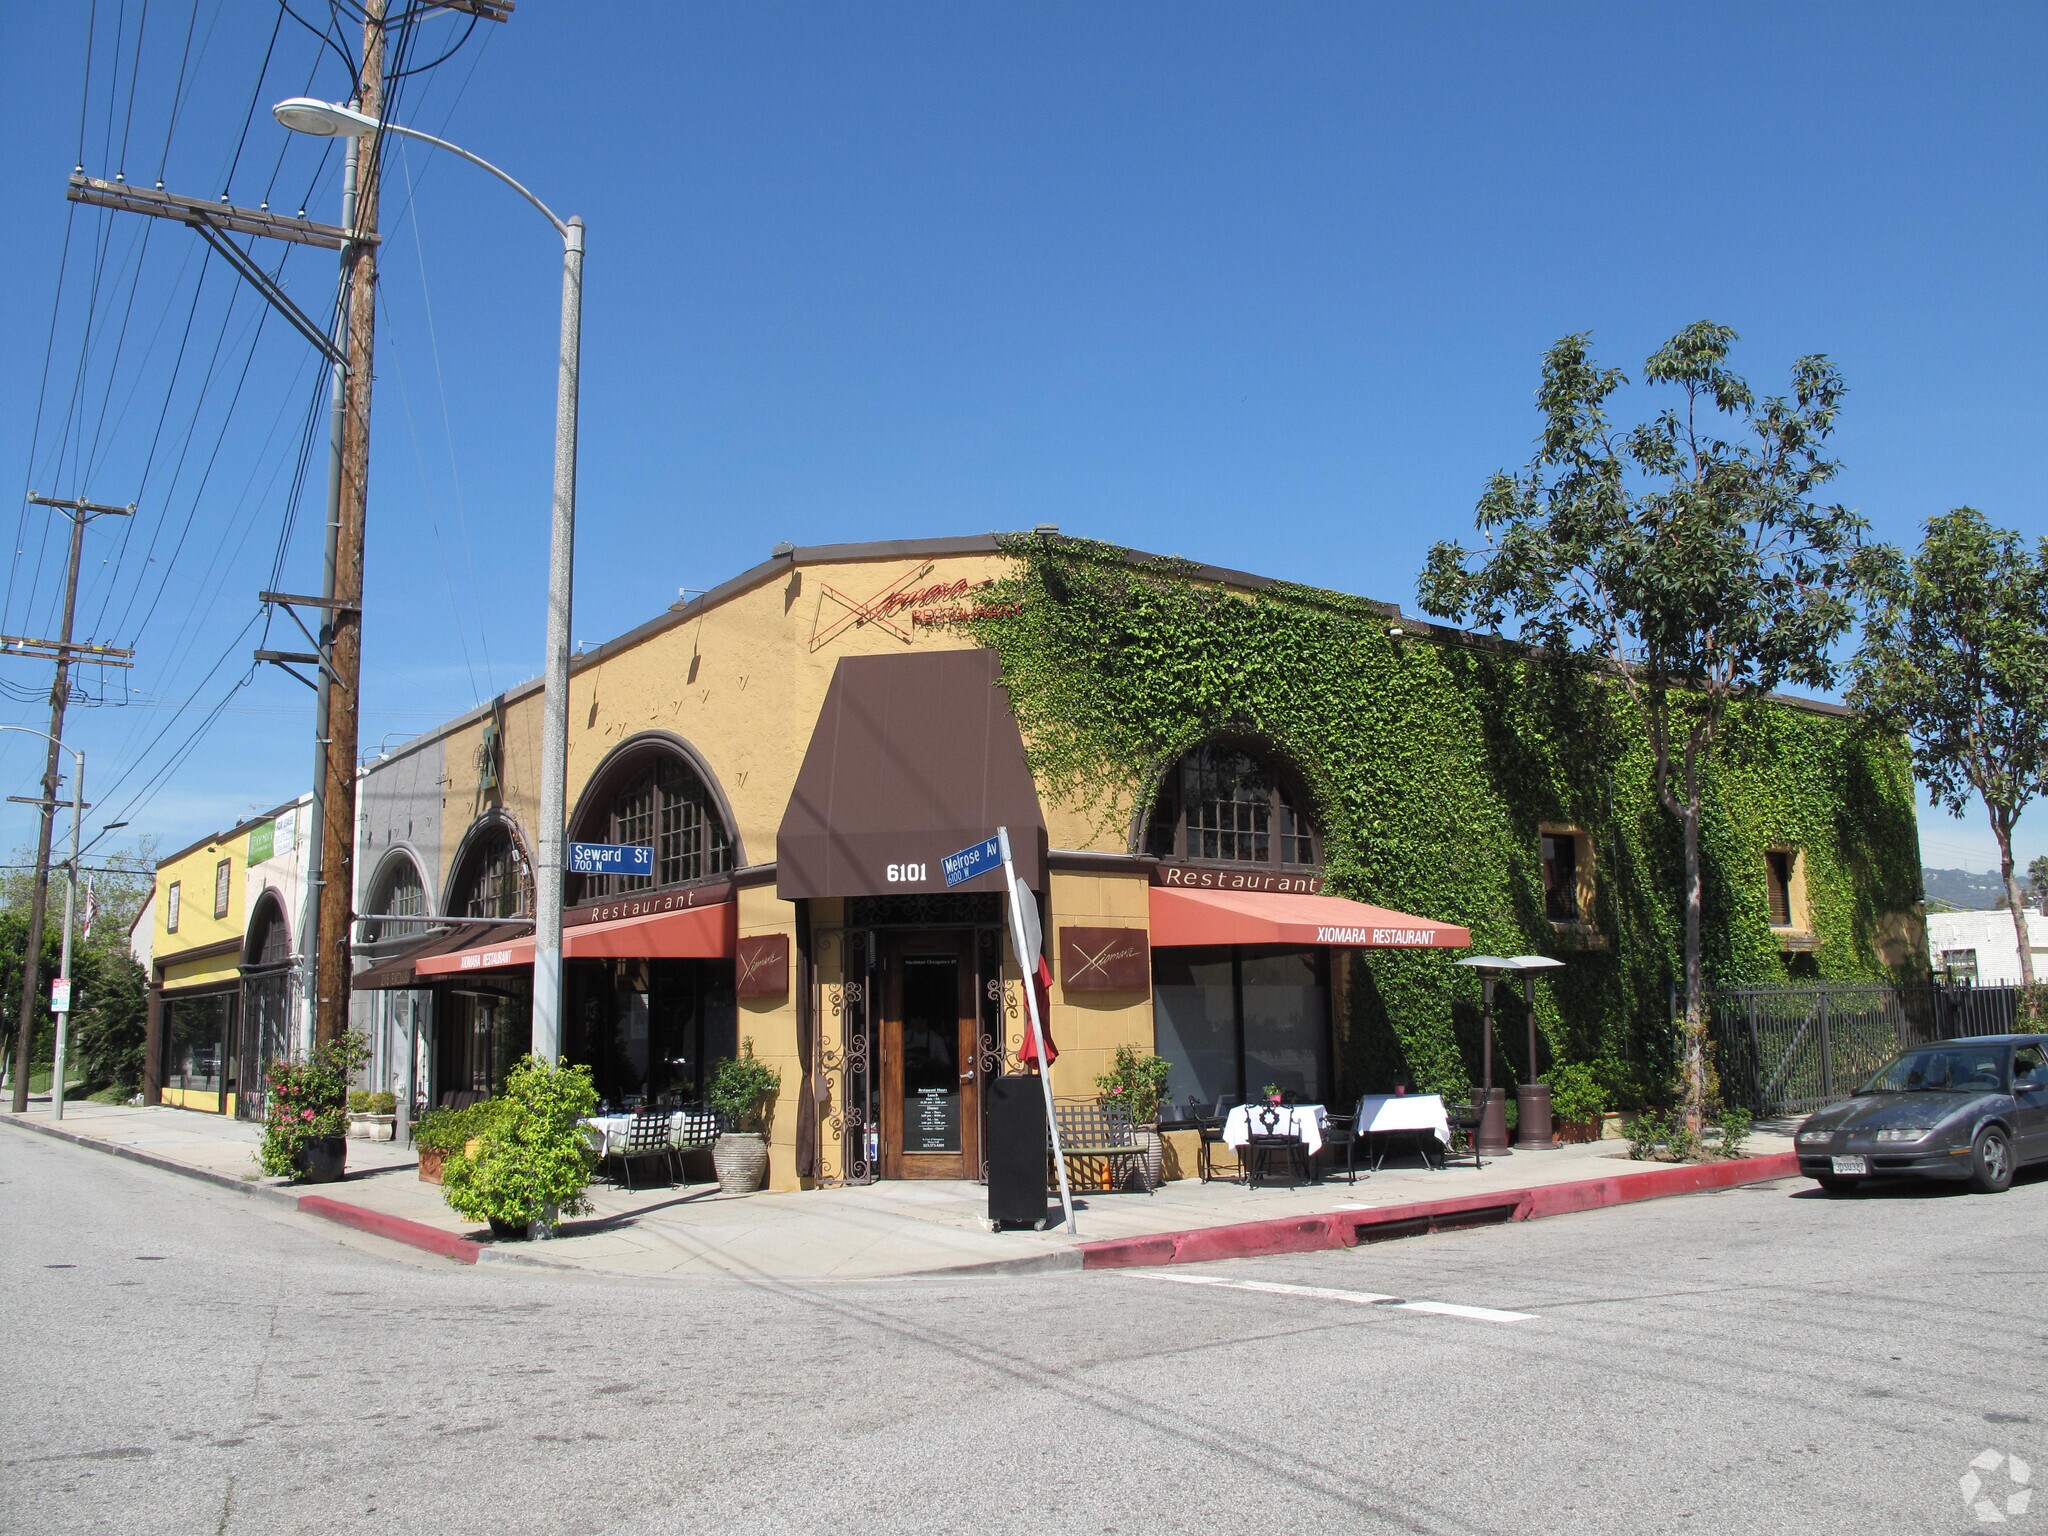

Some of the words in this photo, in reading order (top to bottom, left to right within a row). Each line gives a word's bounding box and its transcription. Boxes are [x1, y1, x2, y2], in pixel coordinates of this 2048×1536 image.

[574, 844, 622, 863] Seward
[634, 848, 649, 864] St
[945, 850, 980, 874] Melrose
[986, 841, 997, 858] Av
[574, 859, 592, 871] 700
[596, 861, 603, 872] N
[886, 862, 927, 882] 6101
[947, 869, 962, 885] 6100
[964, 866, 970, 878] W
[1166, 868, 1318, 893] Restaurant
[591, 890, 695, 922] Restaurant
[1316, 926, 1366, 943] XIOMARA
[1372, 928, 1436, 945] RESTAURANT
[460, 954, 481, 969] XIOMARA
[482, 949, 513, 967] RESTAURANT
